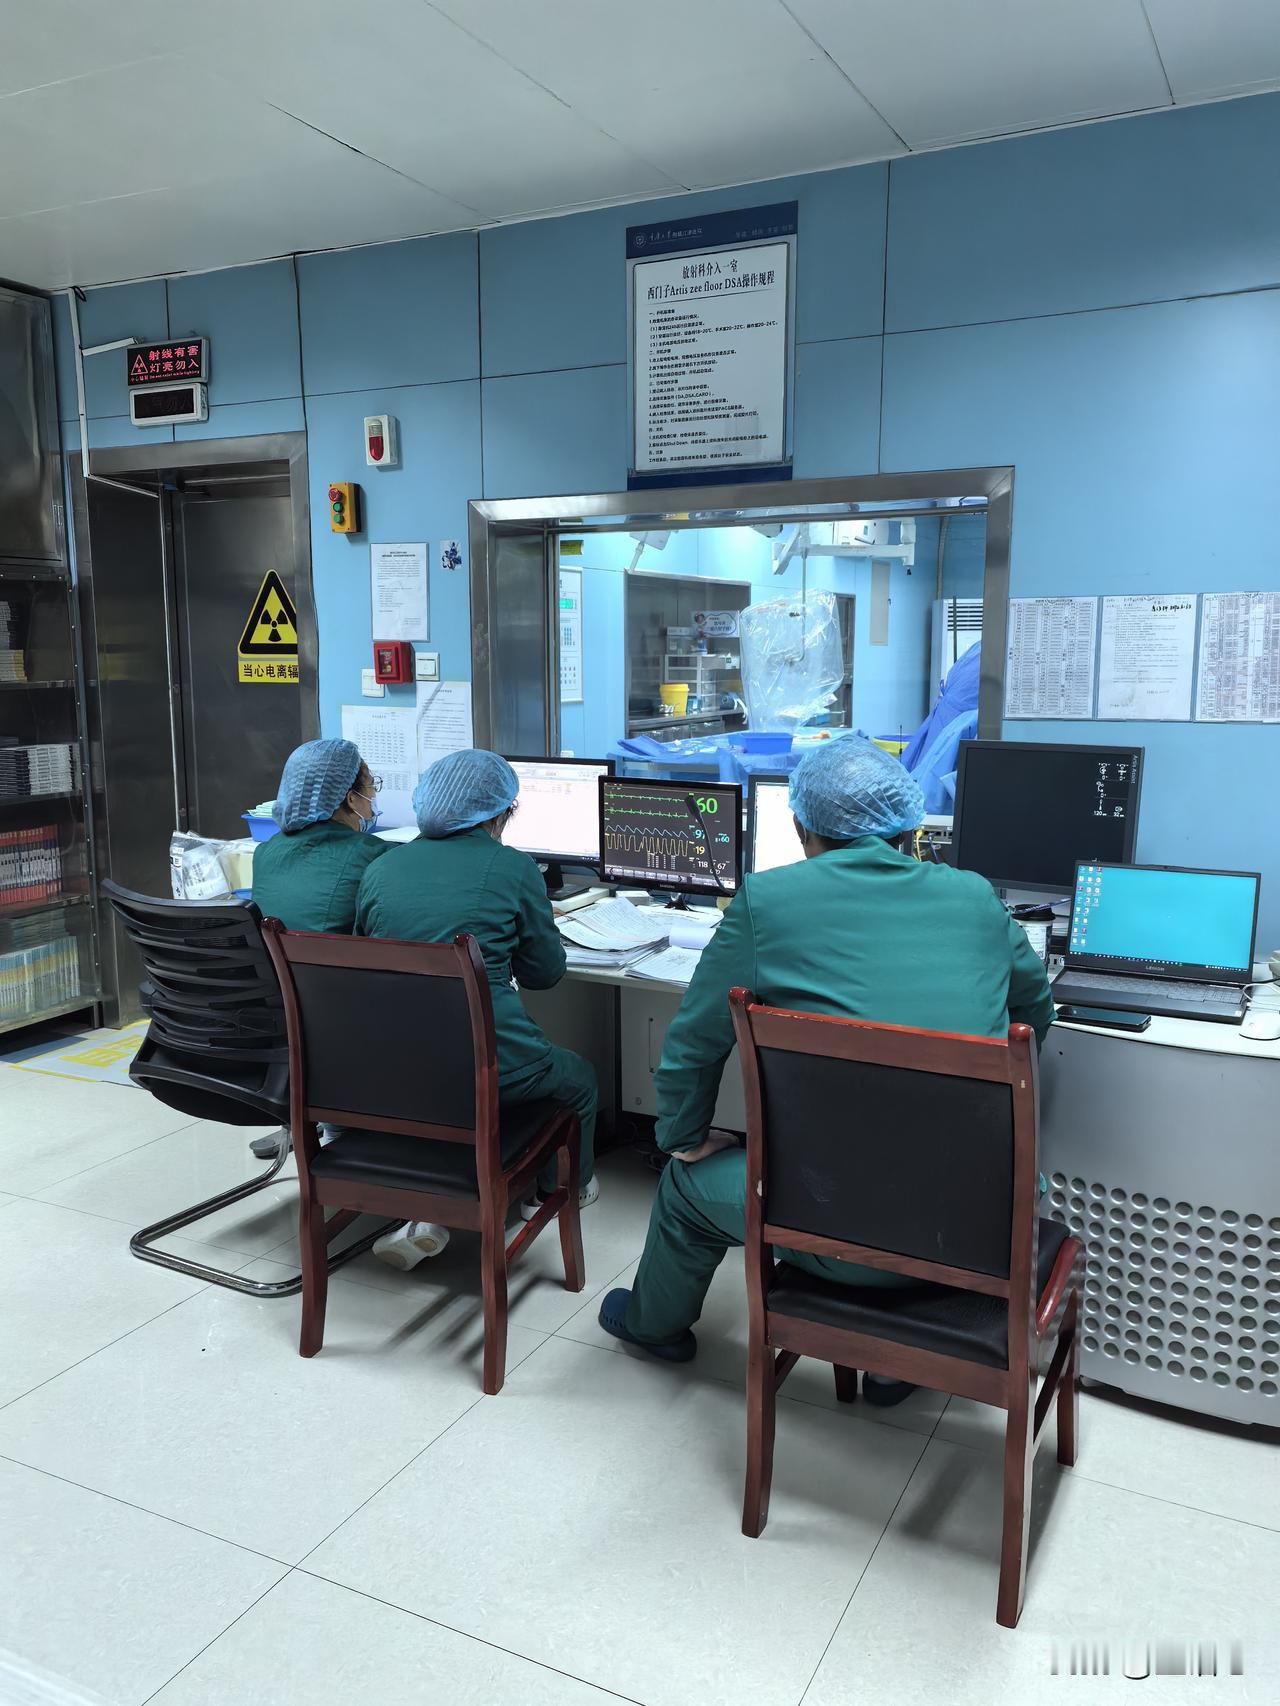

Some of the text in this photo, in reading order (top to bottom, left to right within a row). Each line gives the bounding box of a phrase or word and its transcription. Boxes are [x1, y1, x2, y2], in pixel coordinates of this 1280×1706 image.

[682, 259, 738, 279] 放射科介入一室
[647, 270, 775, 300] 西门子Artis zee floor DSA操作规程
[148, 345, 199, 361] 射线有害
[149, 359, 199, 373] 灯亮勿入
[243, 664, 299, 679] 当心电离辐
[695, 846, 705, 855] 19
